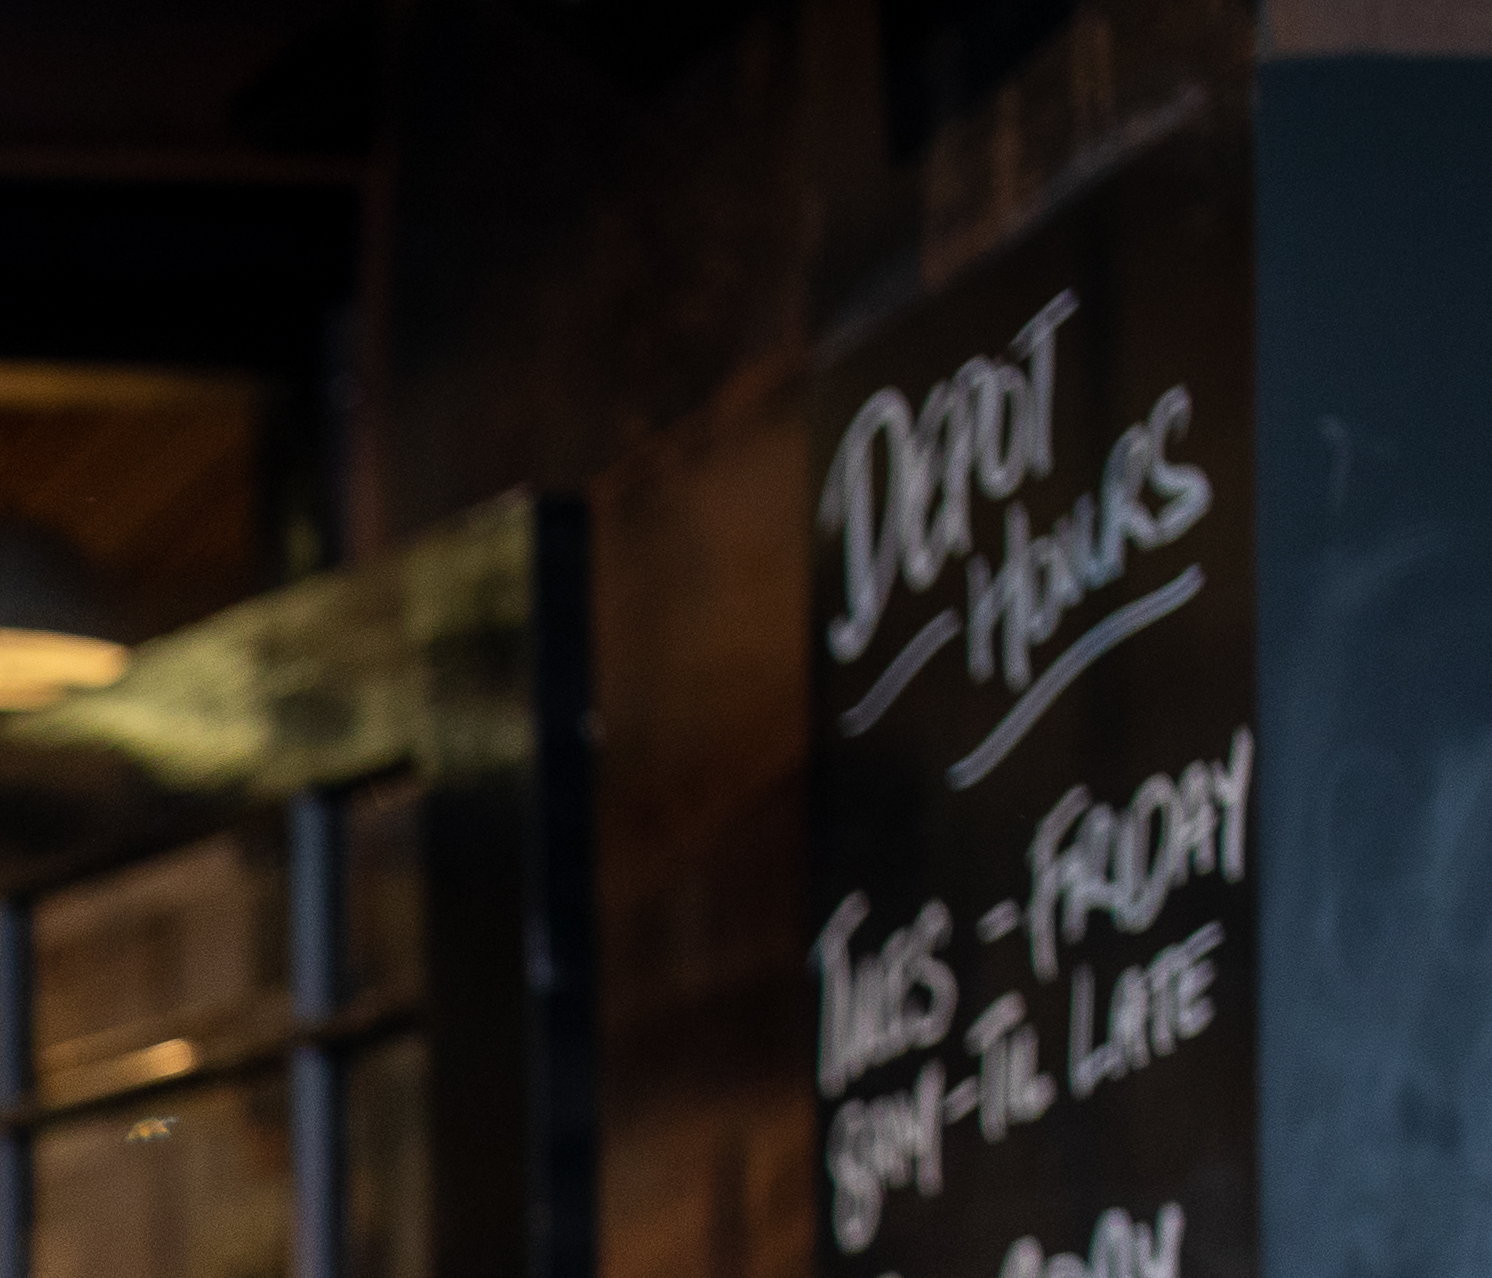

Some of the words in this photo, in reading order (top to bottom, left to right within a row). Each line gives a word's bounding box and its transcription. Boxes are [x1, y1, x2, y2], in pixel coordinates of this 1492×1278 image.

[821, 288, 1079, 662] DEPOT
[967, 385, 1212, 689] HOURS
[1069, 921, 1223, 1098] LATE
